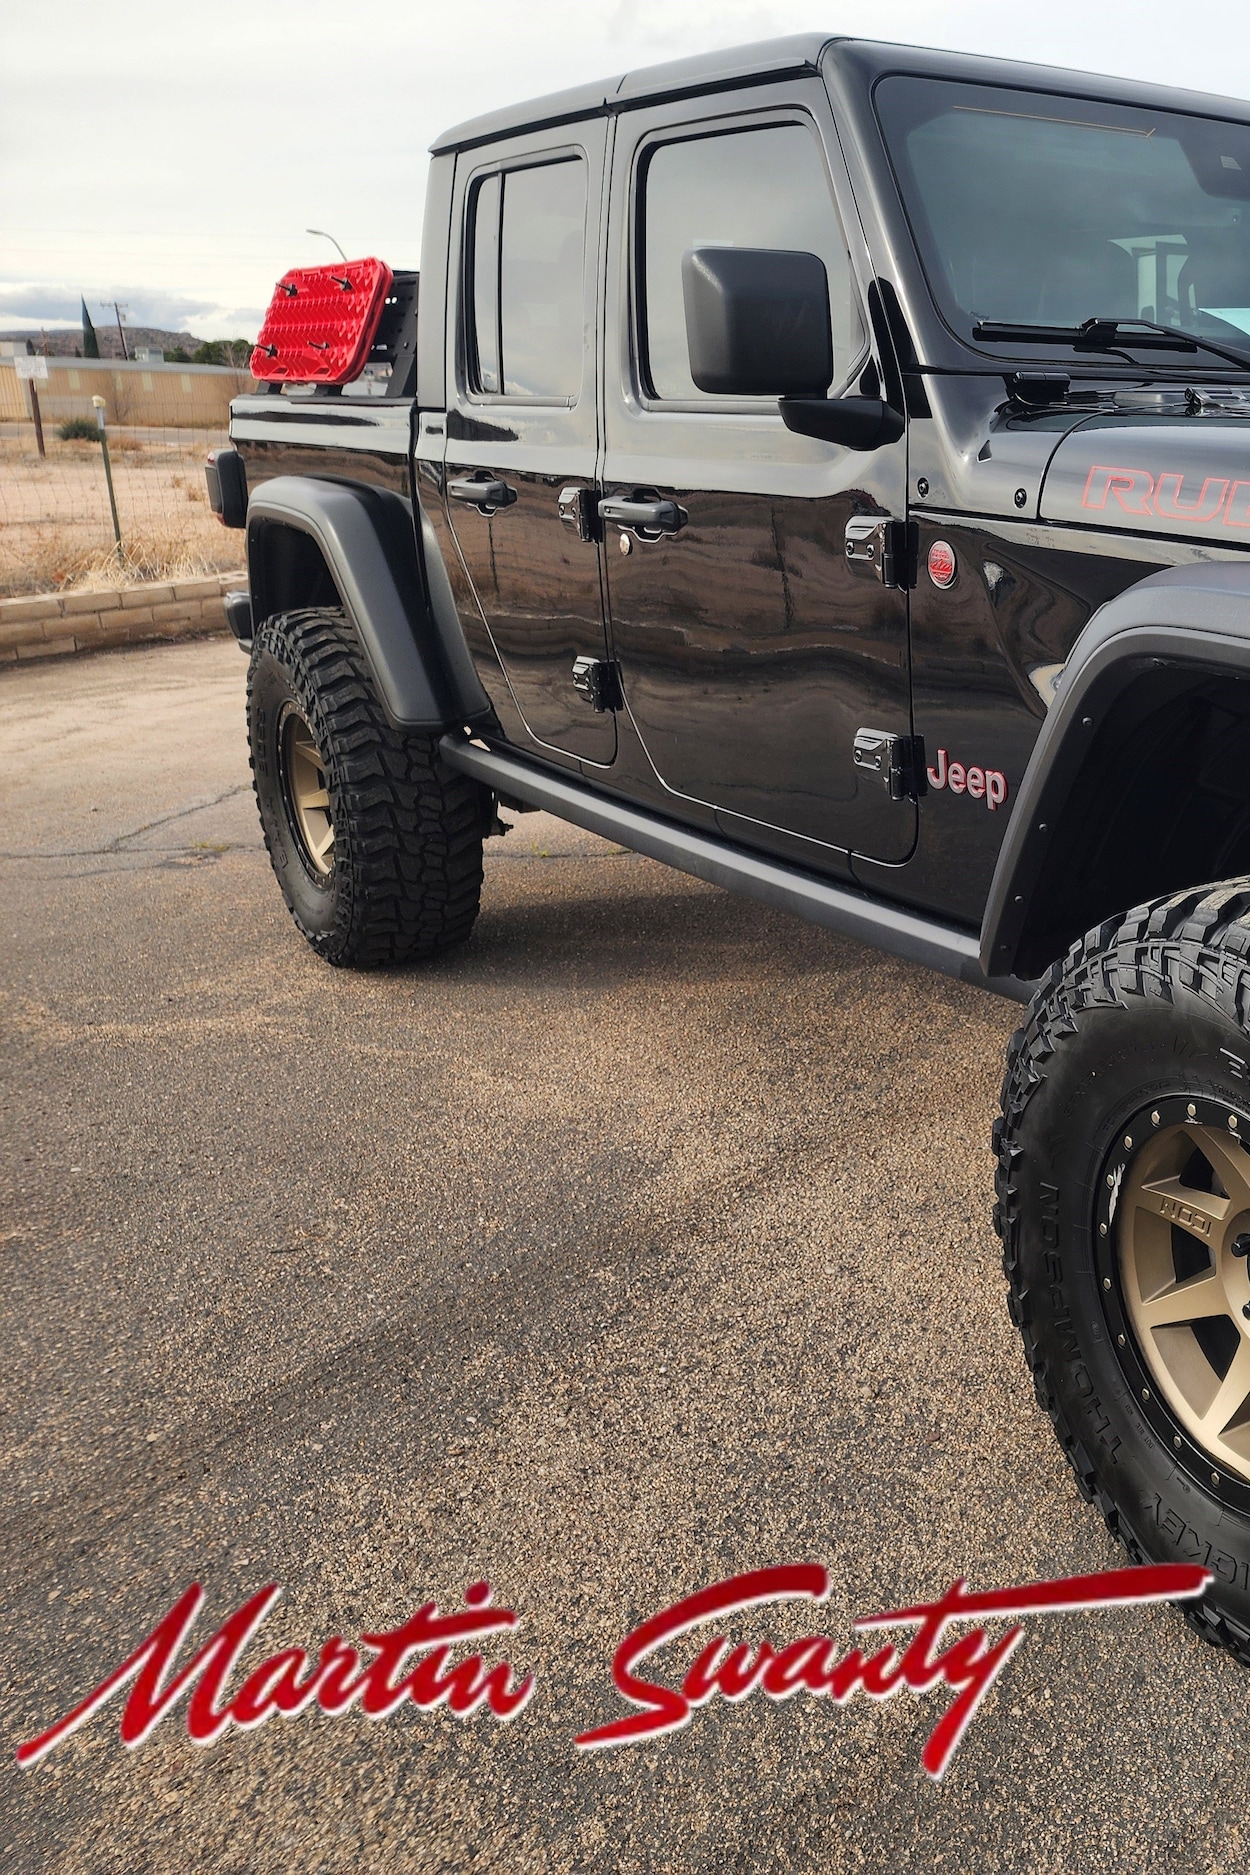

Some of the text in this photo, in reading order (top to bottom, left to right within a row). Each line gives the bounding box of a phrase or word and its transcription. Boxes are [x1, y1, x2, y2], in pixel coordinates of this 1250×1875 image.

[926, 748, 1008, 811] Jeep
[1159, 1198, 1214, 1238] ICON
[1039, 1181, 1122, 1465] THOMPSON
